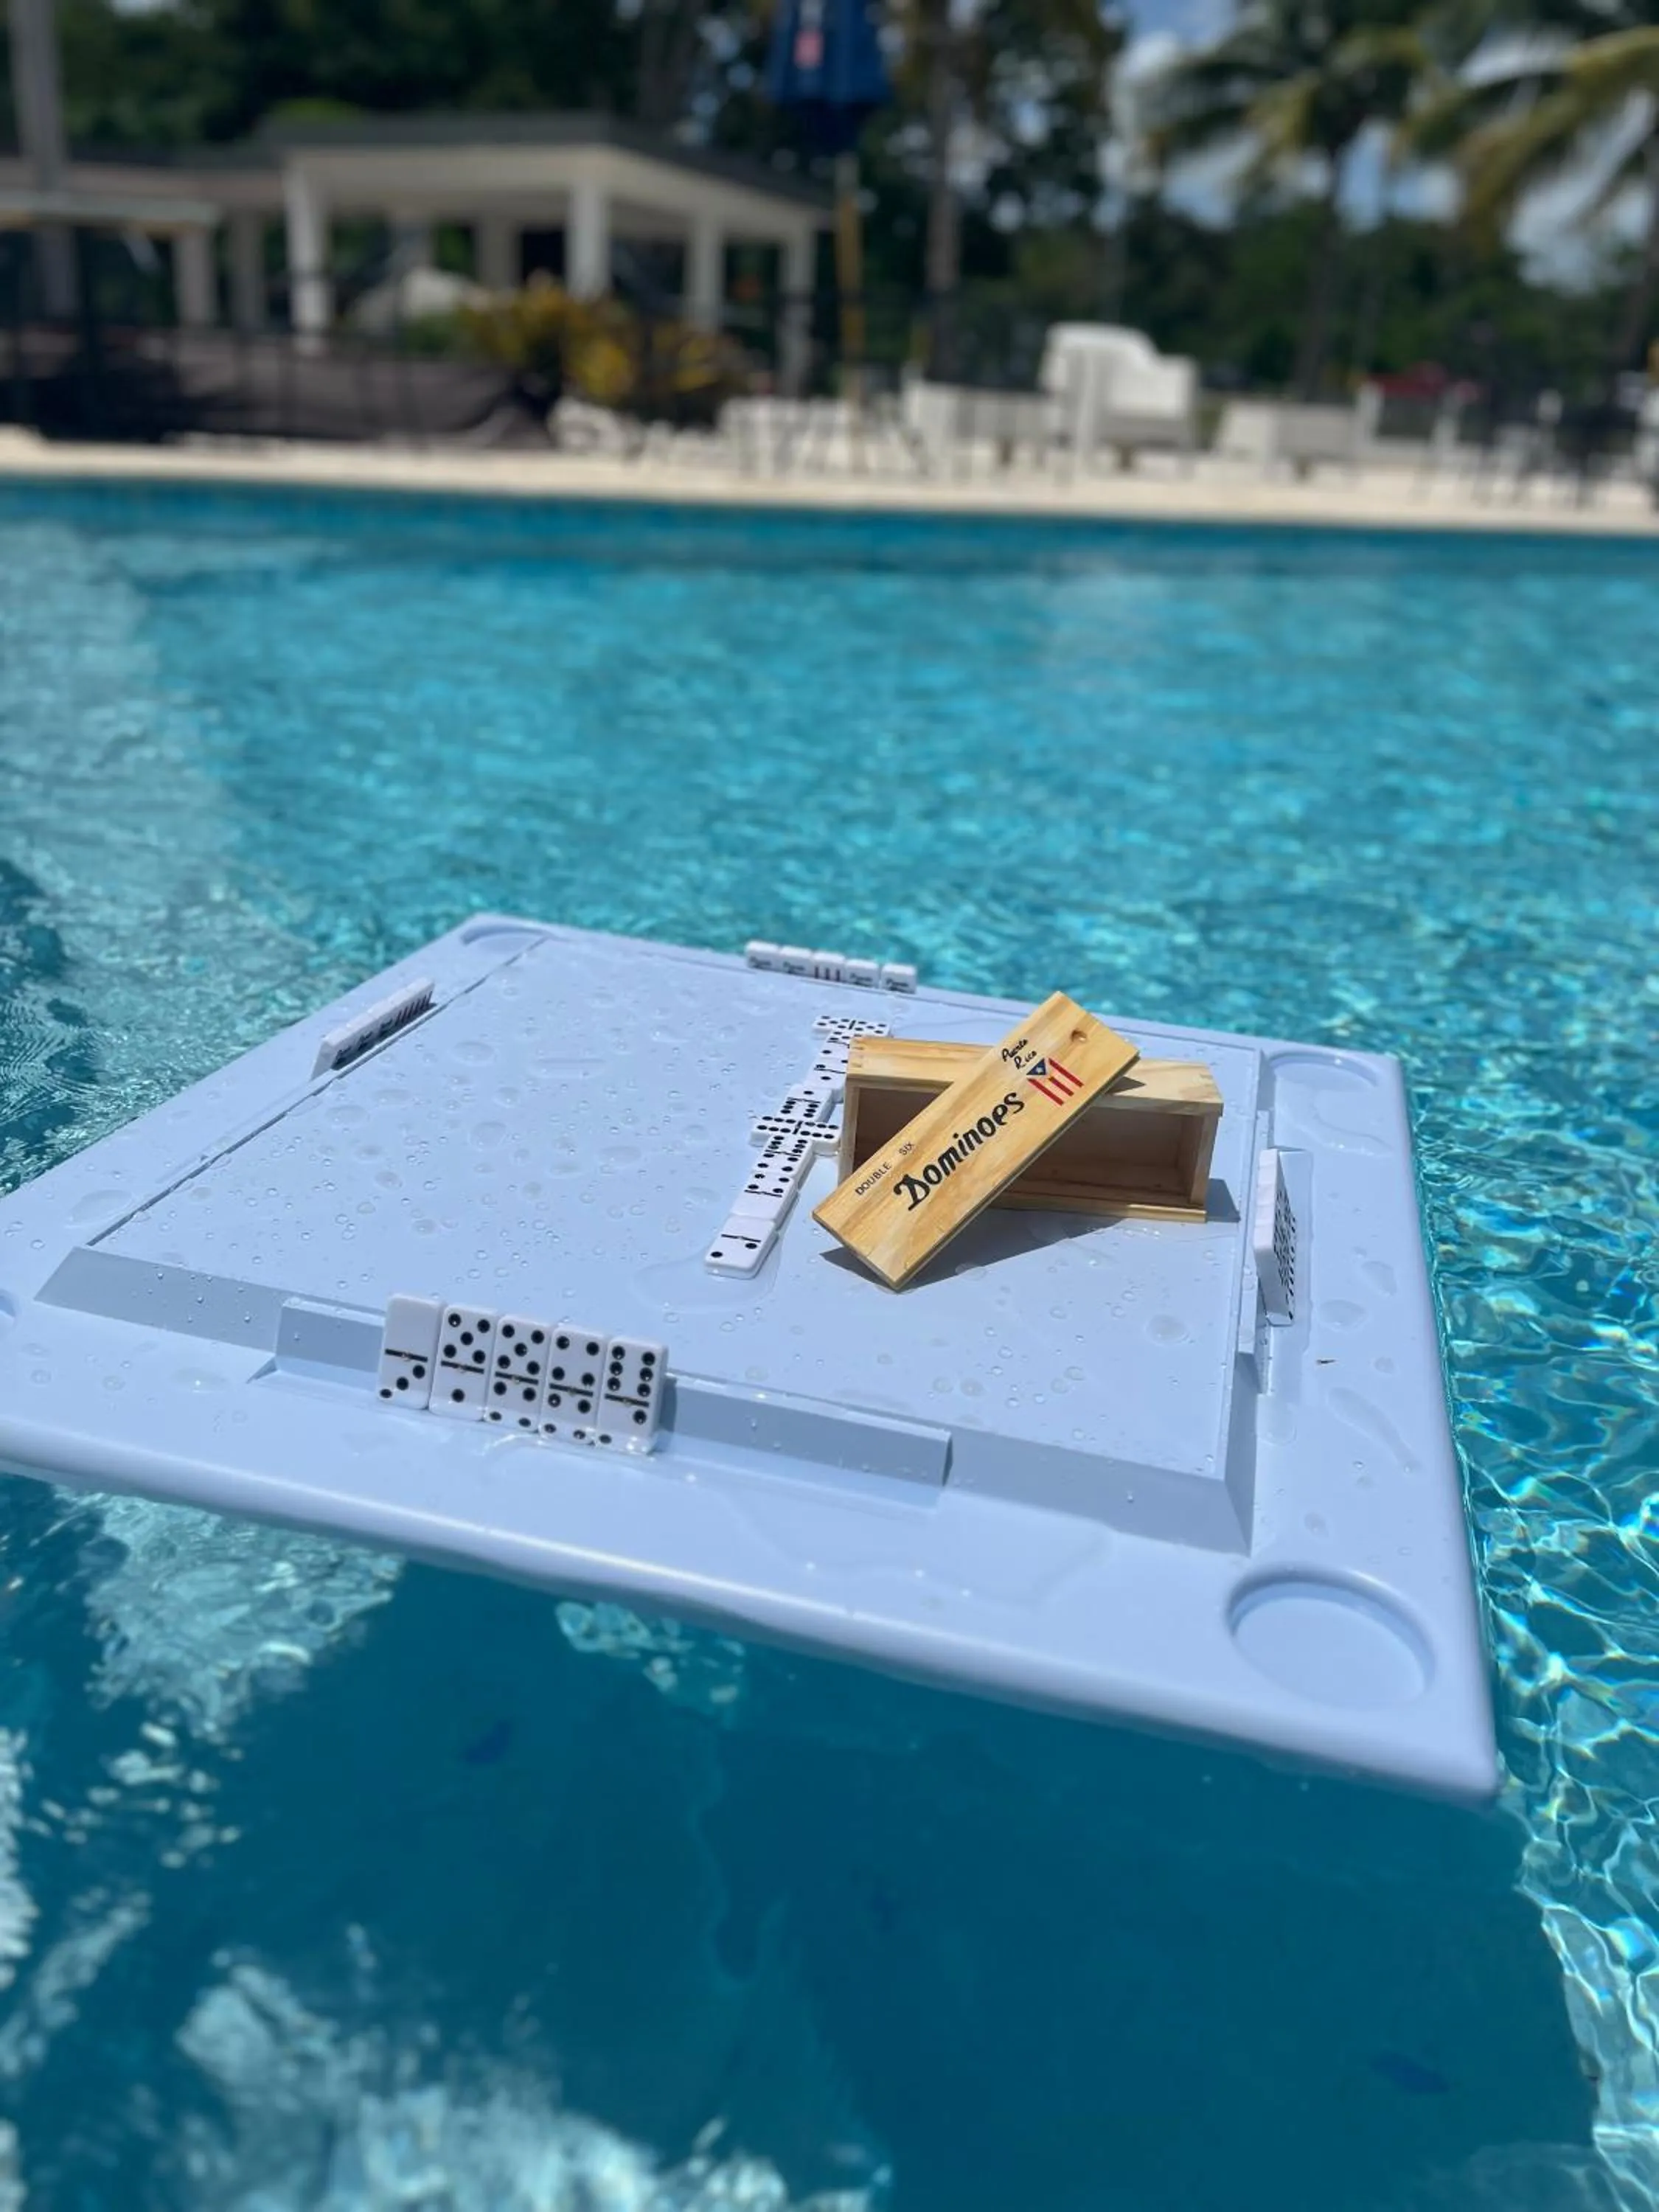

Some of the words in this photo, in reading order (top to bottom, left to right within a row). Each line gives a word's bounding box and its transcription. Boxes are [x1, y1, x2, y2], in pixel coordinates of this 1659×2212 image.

[1001, 1039, 1028, 1062] Puerto
[1014, 1051, 1037, 1069] Rico
[855, 1162, 891, 1195] DOUBLE
[899, 1141, 915, 1155] SIX
[893, 1092, 1025, 1211] Dominoes
